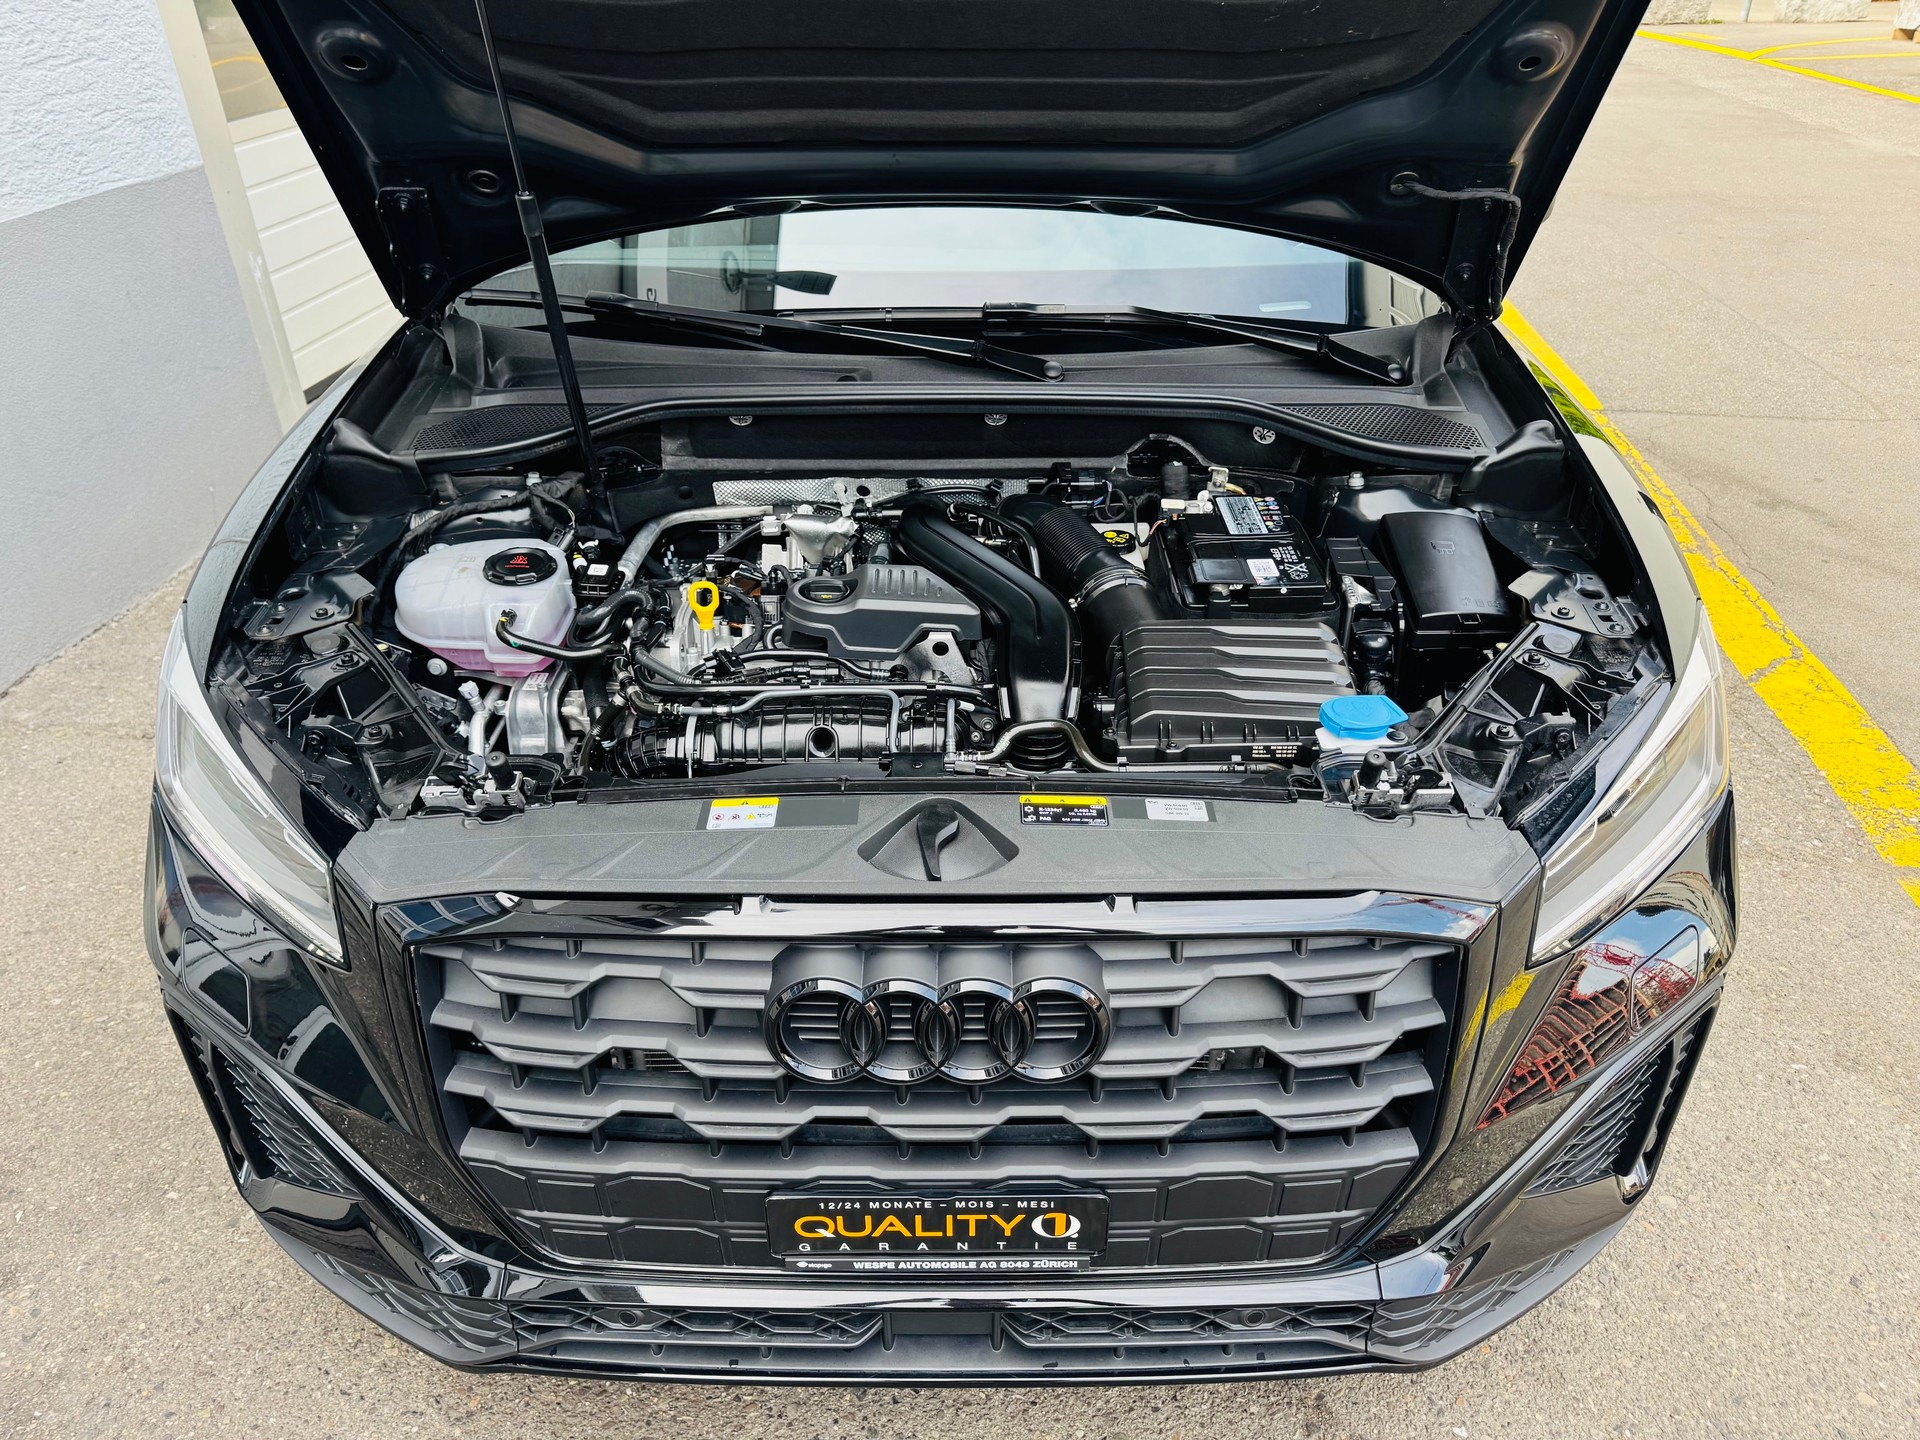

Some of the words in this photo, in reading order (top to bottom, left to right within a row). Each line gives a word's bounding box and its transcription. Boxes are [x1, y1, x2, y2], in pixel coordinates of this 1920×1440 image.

[818, 1201, 861, 1210] 12/24
[869, 1201, 932, 1209] MONATE
[794, 1214, 1026, 1238] QUALITY
[798, 1241, 1077, 1251] GARANTIE
[853, 1261, 895, 1269] WESPE
[898, 1261, 977, 1269] AUTOMOBILE
[980, 1261, 997, 1269] AG
[999, 1260, 1030, 1268] 8048
[1033, 1259, 1078, 1268] ZÜRICH
